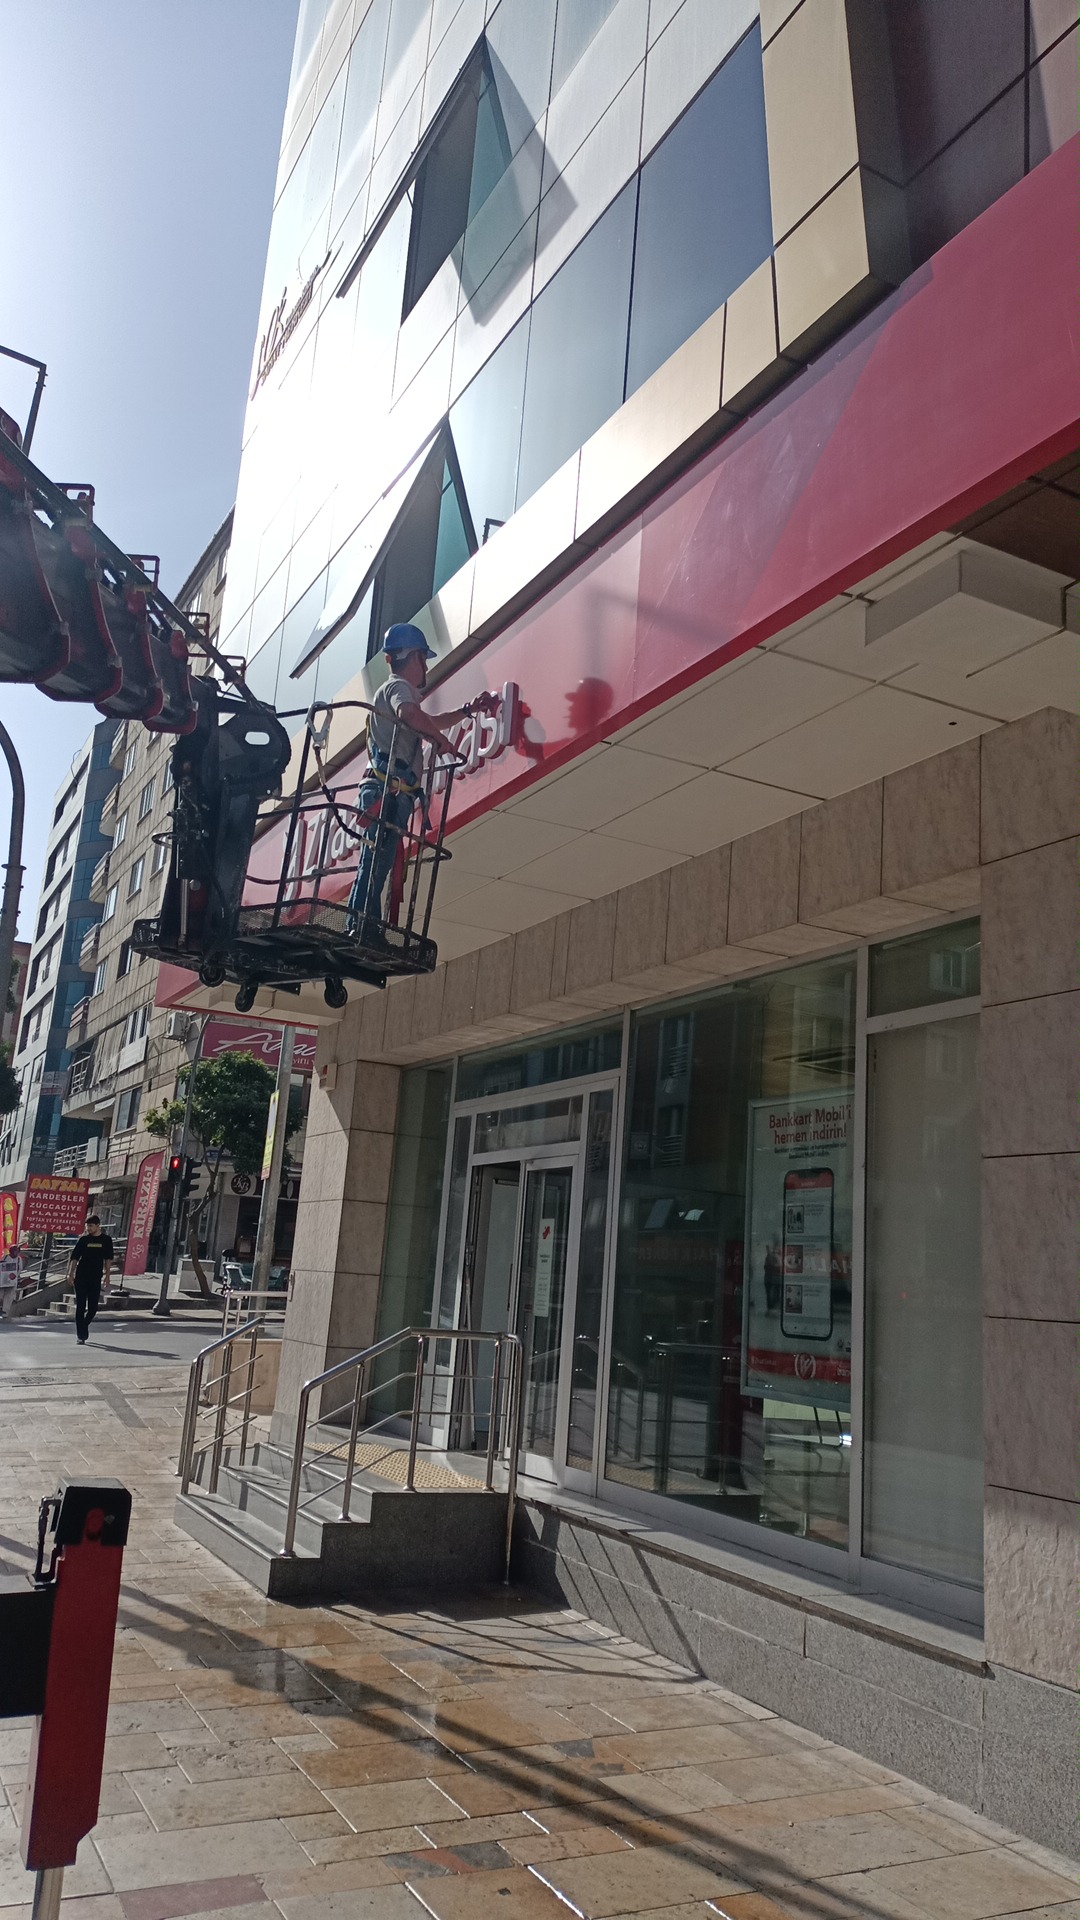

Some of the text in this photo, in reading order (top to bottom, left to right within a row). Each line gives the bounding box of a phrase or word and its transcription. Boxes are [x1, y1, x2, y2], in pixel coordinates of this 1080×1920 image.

[769, 1111, 812, 1129] Bankkart
[774, 1130, 807, 1145] hemen
[30, 1178, 86, 1193] BAYSAL
[29, 1192, 85, 1203] KARDEŞLER
[133, 1166, 154, 1238] KİRAZLI
[31, 1210, 77, 1218] PLASTİK
